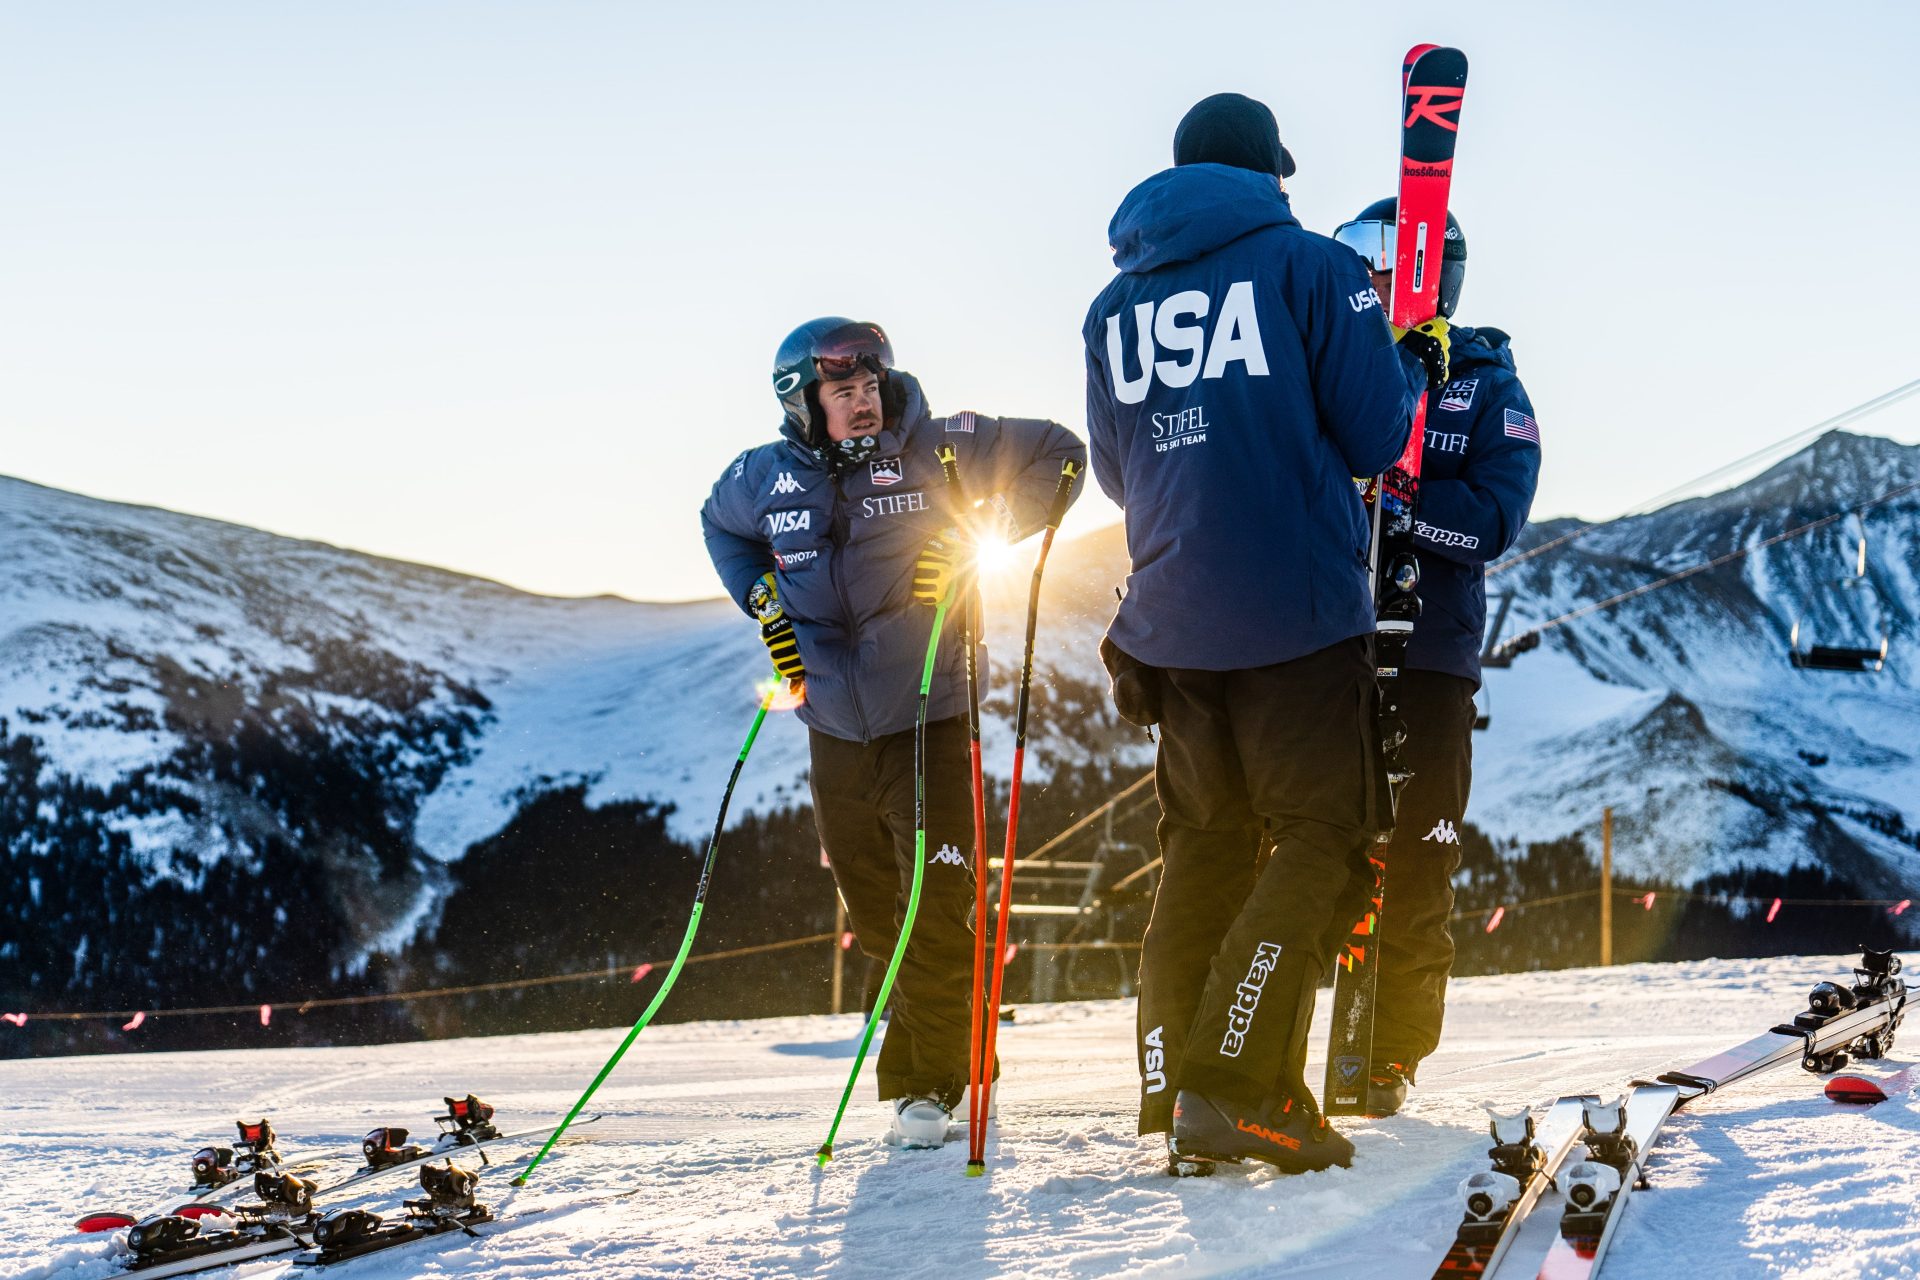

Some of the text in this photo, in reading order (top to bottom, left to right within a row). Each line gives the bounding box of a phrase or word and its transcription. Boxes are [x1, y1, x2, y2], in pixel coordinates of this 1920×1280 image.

[1348, 287, 1382, 313] USA
[1106, 280, 1271, 405] USA
[1449, 379, 1476, 391] US
[1151, 405, 1210, 438] STIFEL
[1155, 433, 1207, 452] US SKI TEAM
[862, 492, 930, 519] STIFEL
[766, 510, 811, 535] VISA
[782, 550, 818, 564] TOYOTA
[768, 619, 790, 632] LEVEL
[1220, 941, 1282, 1058] Kappa
[1145, 1025, 1167, 1094] USA
[1237, 1118, 1302, 1151] LANGE
